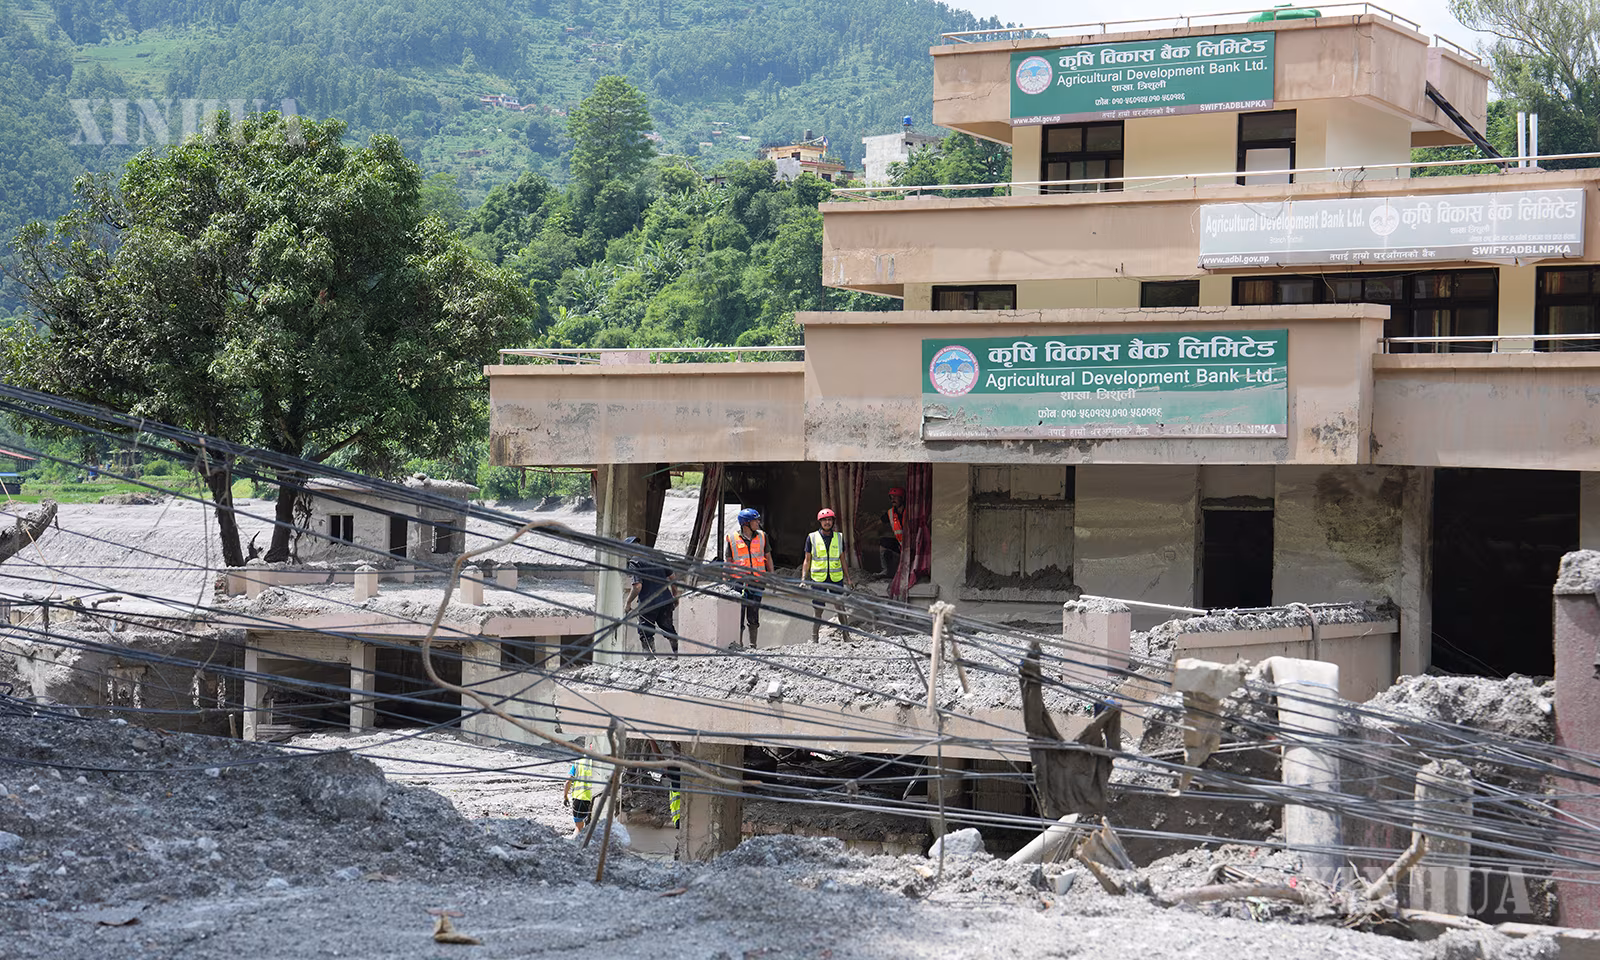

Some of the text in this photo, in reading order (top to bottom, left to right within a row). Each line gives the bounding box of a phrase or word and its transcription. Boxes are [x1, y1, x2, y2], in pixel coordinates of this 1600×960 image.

[1058, 38, 1268, 71] कृषि विकास बैंक लिमिटेड
[1057, 59, 1268, 87] Agricultural Development Bank Ltd.
[1200, 100, 1267, 112] SWIFT:ADBLNPKA
[1205, 207, 1365, 238] Agricultural Development Bank Ltd.
[1402, 197, 1579, 229] कृषि विकास बैंक लिमिटेड
[1203, 254, 1270, 265] www.adbl.gov.np
[1472, 244, 1571, 255] SWIFT:ADBLNPKA
[988, 335, 1279, 368] कृषि विकास बैंक लिमिटेड
[985, 367, 1279, 391] Agricultural Development Bank Ltd.
